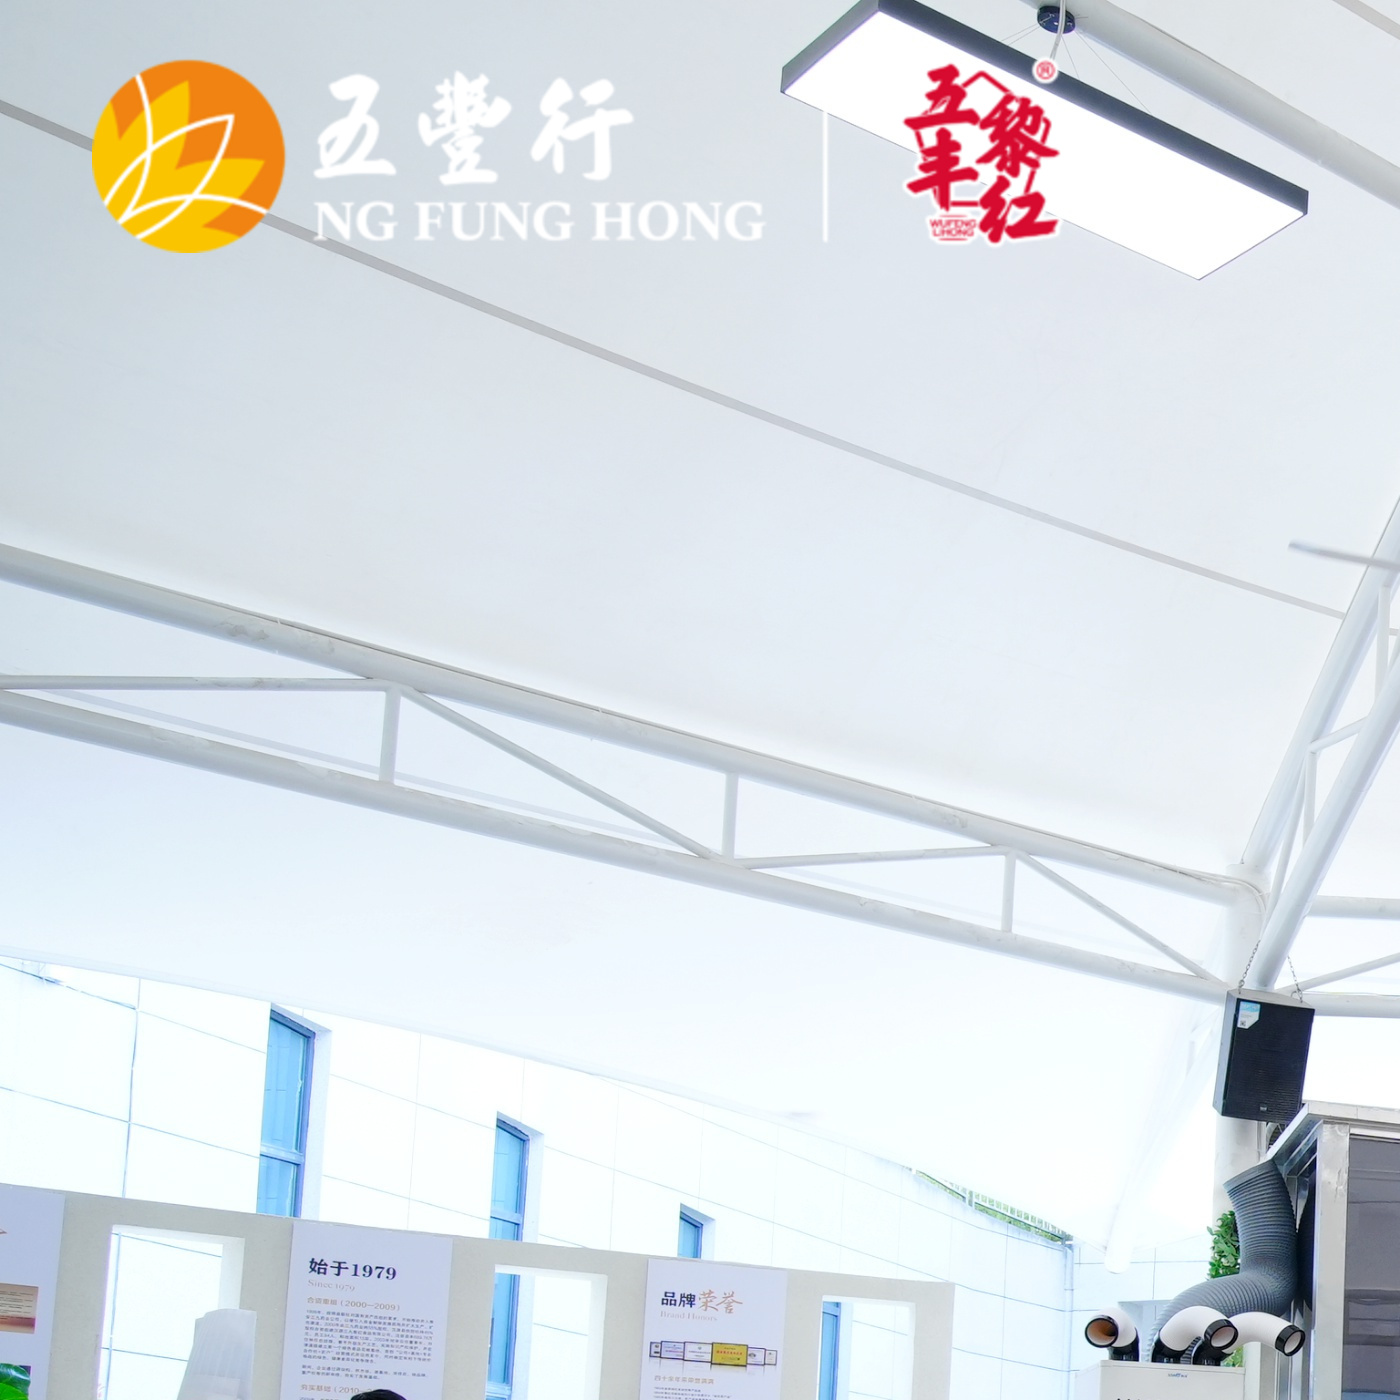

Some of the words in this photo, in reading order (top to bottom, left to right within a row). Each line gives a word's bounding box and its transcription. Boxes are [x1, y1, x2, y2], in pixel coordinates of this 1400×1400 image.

[308, 1257, 397, 1281] 始于1979
[661, 1289, 743, 1314] 品牌荣誉
